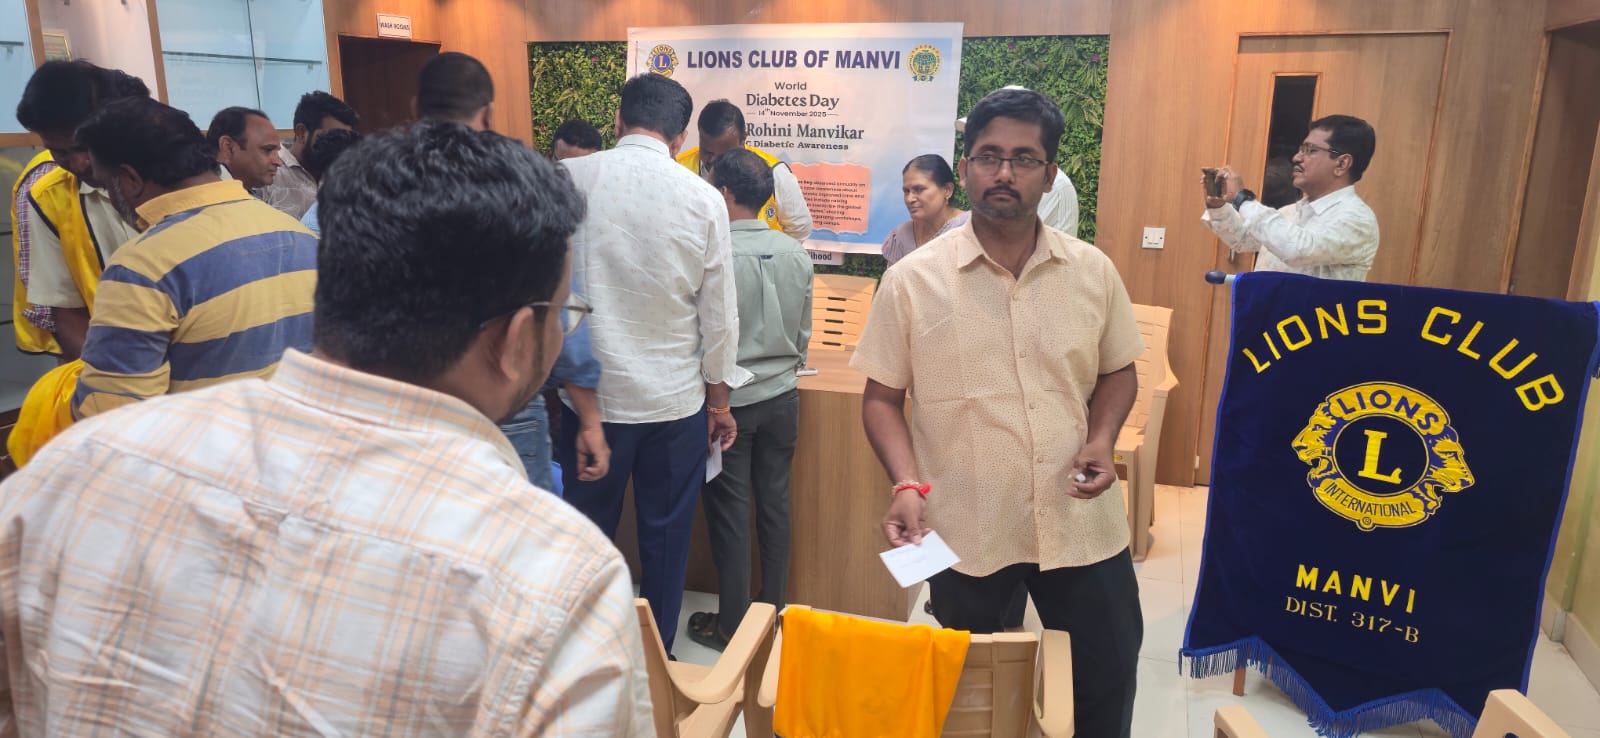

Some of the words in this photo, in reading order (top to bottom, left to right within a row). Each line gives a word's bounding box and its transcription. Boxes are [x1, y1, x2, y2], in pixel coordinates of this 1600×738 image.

[658, 55, 667, 68] L
[687, 51, 743, 69] LIONS
[748, 50, 797, 68] CLUB
[804, 49, 829, 68] OF
[835, 50, 901, 69] MANVI
[774, 82, 807, 91] World
[746, 92, 807, 107] Diabetes
[809, 94, 840, 110] Day
[746, 122, 791, 137] Rohini
[797, 123, 865, 140] Manvikar
[753, 140, 795, 149] Diabetic
[797, 141, 849, 151] Awareness
[1242, 299, 1387, 374] LIONS
[1421, 306, 1565, 411] CLUB
[1337, 389, 1439, 431] LIONS
[1357, 429, 1402, 484] L
[1323, 481, 1417, 518] INTERNATIONAL
[1295, 563, 1416, 615] MANVI
[1285, 596, 1338, 623] DIST.
[1351, 611, 1420, 644] 317-B
